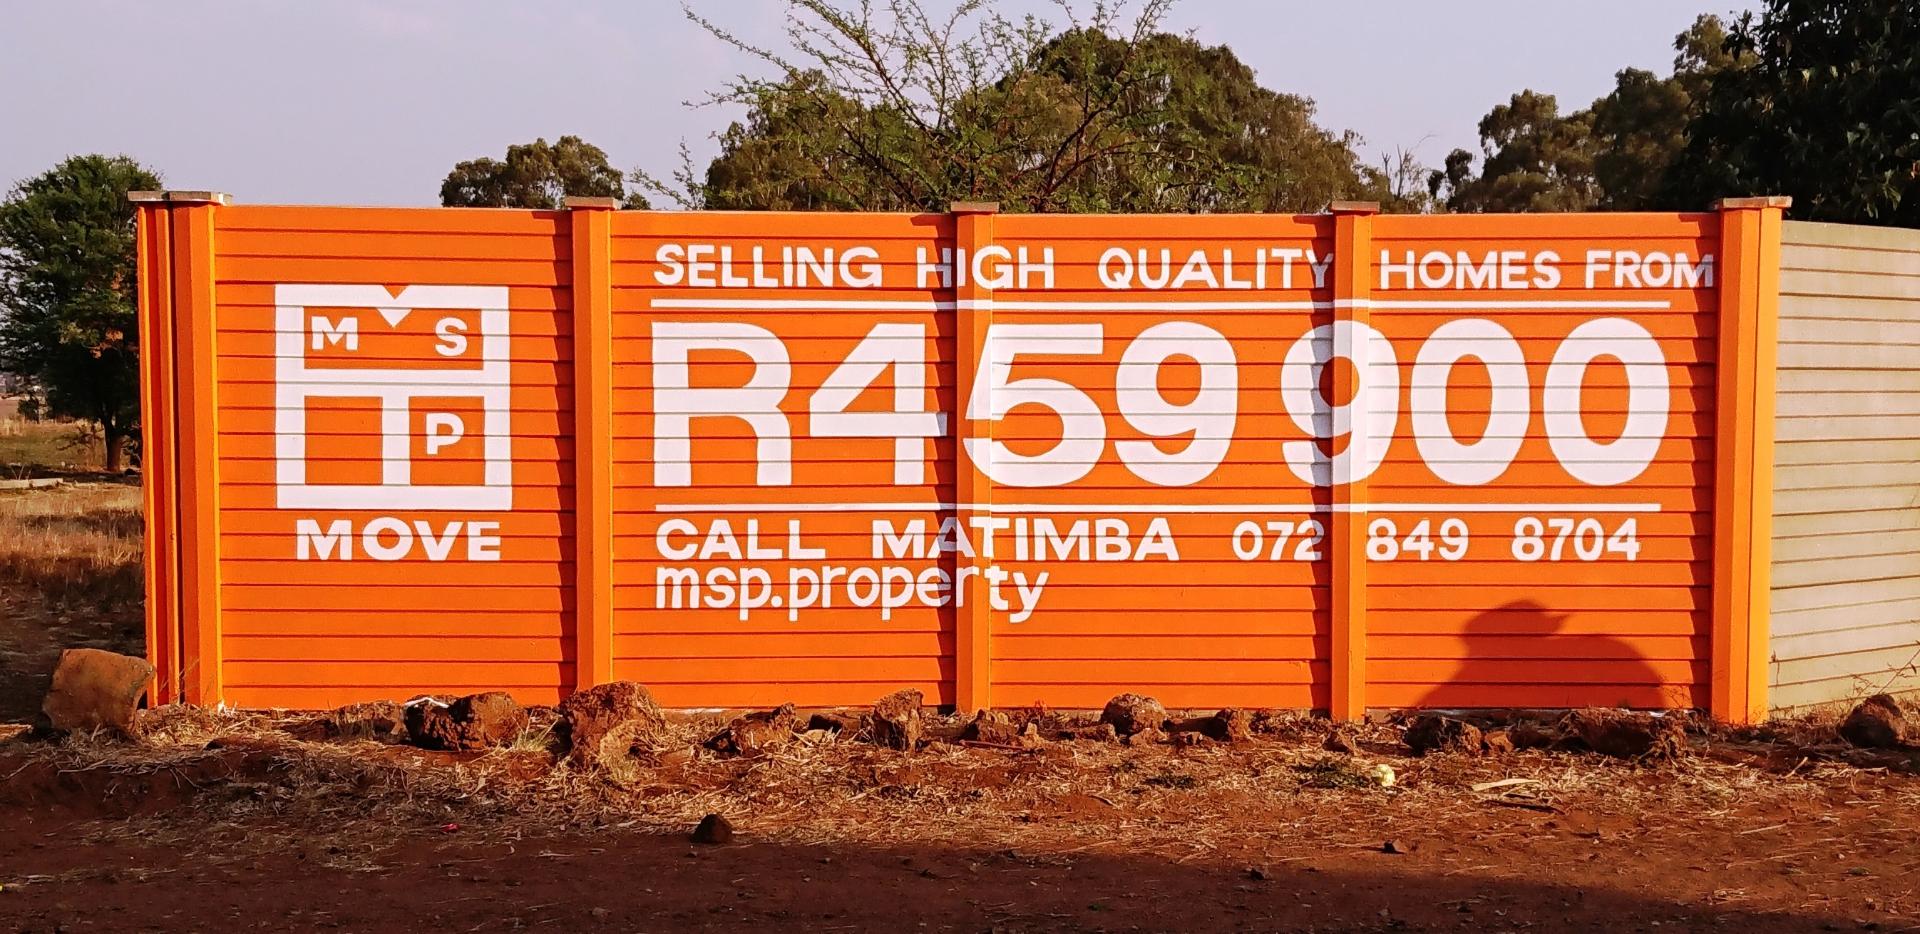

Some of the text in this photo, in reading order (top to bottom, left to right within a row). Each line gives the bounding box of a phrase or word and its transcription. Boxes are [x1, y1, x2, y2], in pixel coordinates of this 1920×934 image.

[653, 243, 1714, 290] SELLING HIGH QUALITY HOMES FROM
[311, 315, 468, 357] M S
[651, 317, 1671, 488] R459 900
[425, 412, 465, 455] P
[296, 517, 501, 561] MOVE
[655, 515, 1641, 562] CALL MATIMBA 072 849 8704
[655, 564, 1050, 624] msp.property
